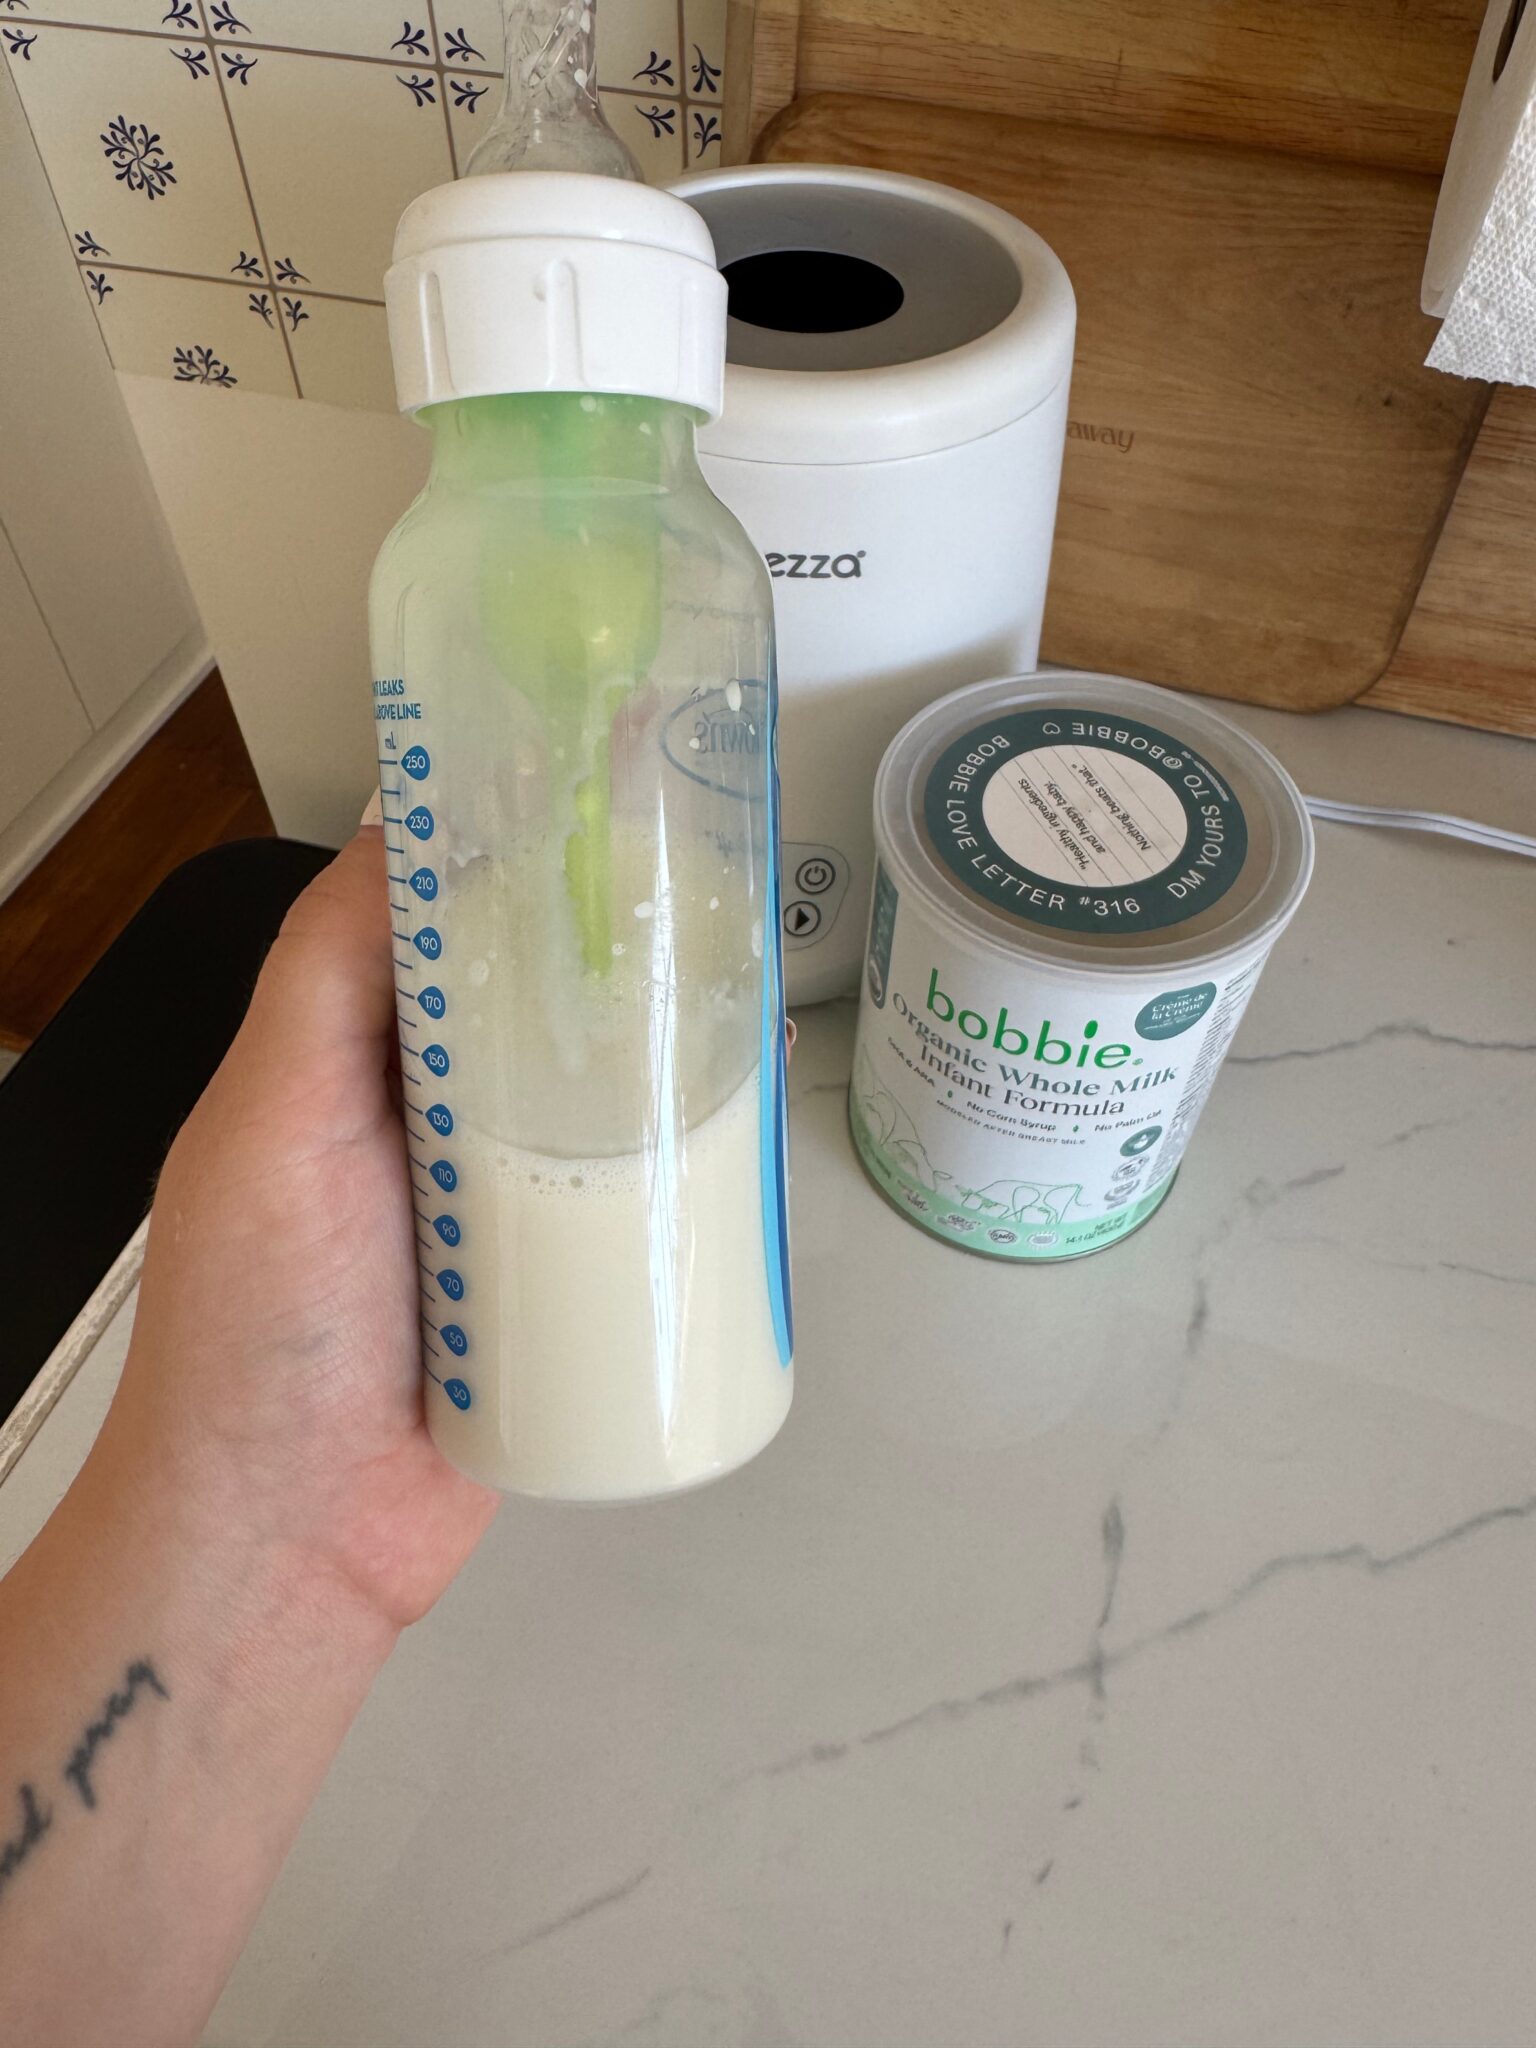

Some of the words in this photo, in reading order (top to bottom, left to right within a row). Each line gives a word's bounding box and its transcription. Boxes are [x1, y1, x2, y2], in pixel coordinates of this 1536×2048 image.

[764, 551, 863, 579] ezza
[379, 679, 405, 696] LEAKS
[397, 702, 422, 720] LINE
[1072, 722, 1183, 769] @BOBBIE
[405, 754, 427, 770] 250
[949, 735, 1011, 792] BOBBIE
[1184, 774, 1211, 799] TO
[1018, 778, 1061, 829] ingredients
[1095, 786, 1121, 814] beats
[410, 815, 430, 830] 230
[947, 799, 978, 850] LOVE
[1063, 806, 1091, 835] happy
[1117, 813, 1152, 851] Nothing
[1083, 835, 1106, 854] and
[1195, 804, 1225, 868] YOURS
[415, 875, 434, 891] 210
[971, 853, 1065, 910] LETTER
[1167, 869, 1206, 899] DM
[1079, 896, 1141, 917] #316
[420, 935, 438, 951] 190
[424, 994, 442, 1011] 170
[927, 968, 1131, 1069] bobbie
[893, 992, 988, 1073] Organic
[998, 1063, 1101, 1096] Whole
[1110, 1067, 1179, 1096] Milk
[428, 1052, 445, 1068] 150
[921, 1044, 994, 1098] Infant
[1003, 1089, 1125, 1117] Formula
[432, 1112, 449, 1128] 130
[966, 1101, 984, 1114] No
[1020, 1118, 1057, 1132] Syrup
[438, 1167, 453, 1183] 110
[442, 1223, 457, 1238] 90
[446, 1276, 460, 1292] 70
[449, 1332, 464, 1348] 50
[453, 1386, 467, 1401] 30
